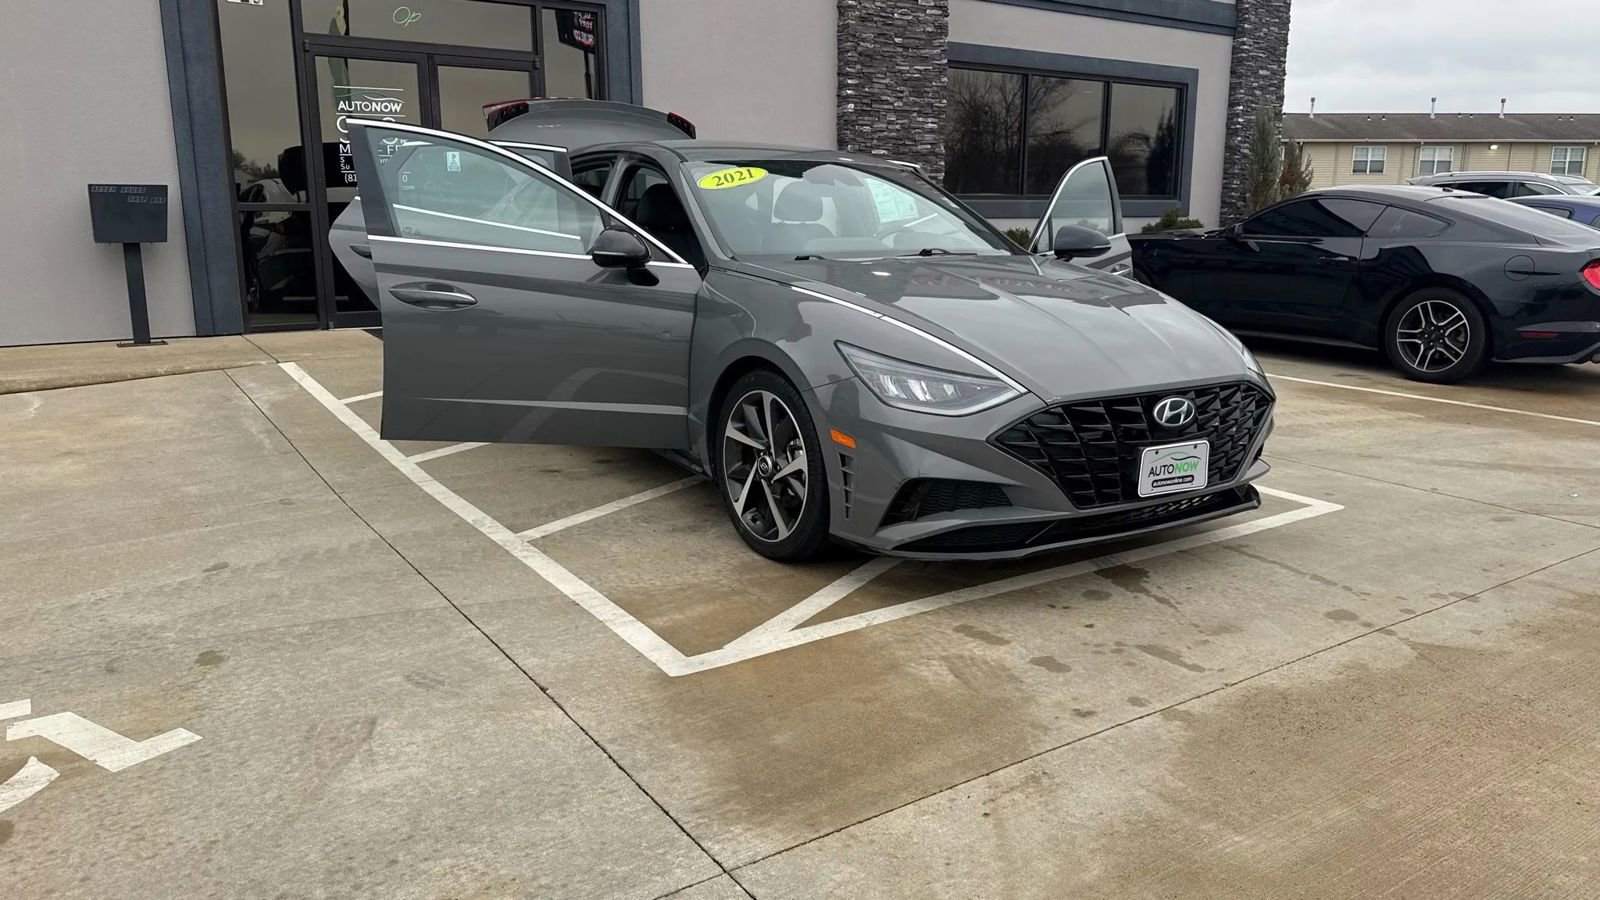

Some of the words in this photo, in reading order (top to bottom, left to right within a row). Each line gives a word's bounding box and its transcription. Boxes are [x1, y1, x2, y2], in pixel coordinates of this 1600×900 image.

[337, 100, 402, 112] AUTONOW
[712, 168, 754, 187] 2021
[1147, 460, 1200, 478] AUTONOW
